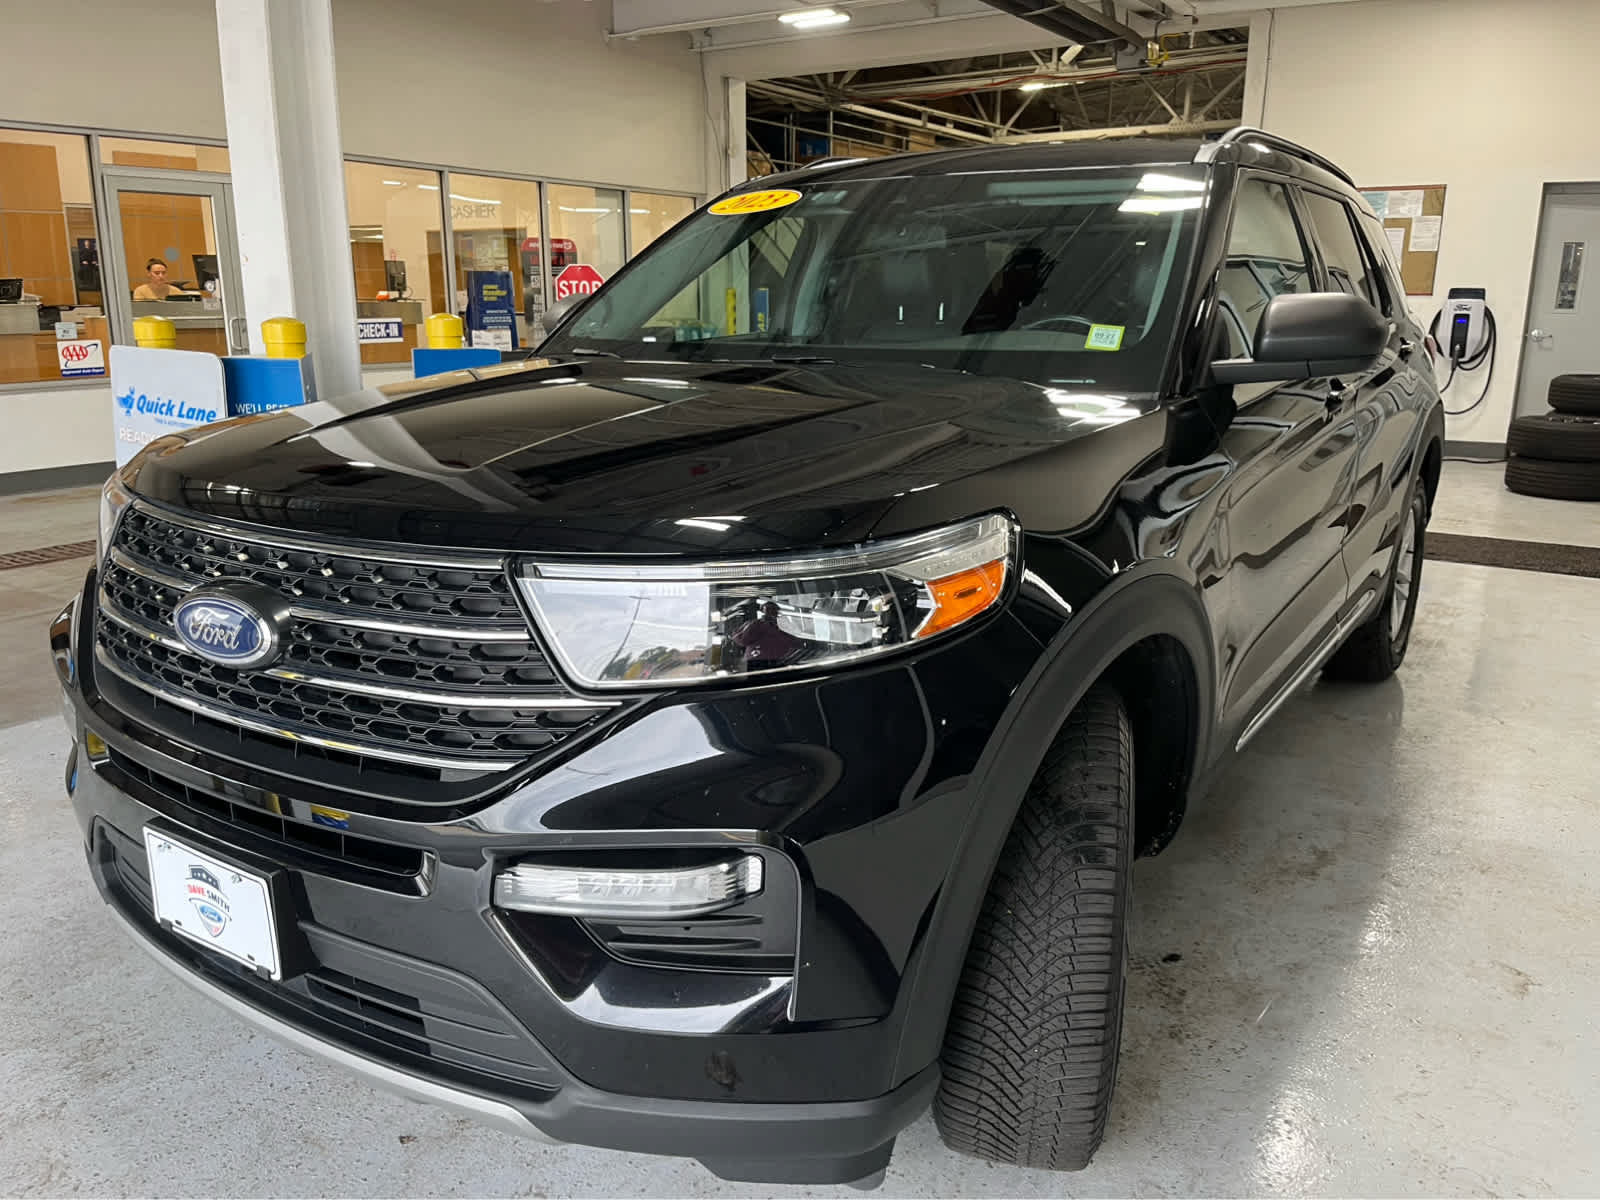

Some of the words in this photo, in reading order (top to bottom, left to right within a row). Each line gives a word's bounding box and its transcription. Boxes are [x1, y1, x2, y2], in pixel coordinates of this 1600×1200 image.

[560, 281, 603, 298] STOP
[359, 323, 399, 338] CHECK-IN
[61, 345, 89, 361] AAA
[136, 394, 175, 416] Quick
[177, 401, 217, 423] Lane
[188, 606, 242, 651] Ford
[187, 884, 206, 897] DAVE
[206, 889, 230, 913] SMITH
